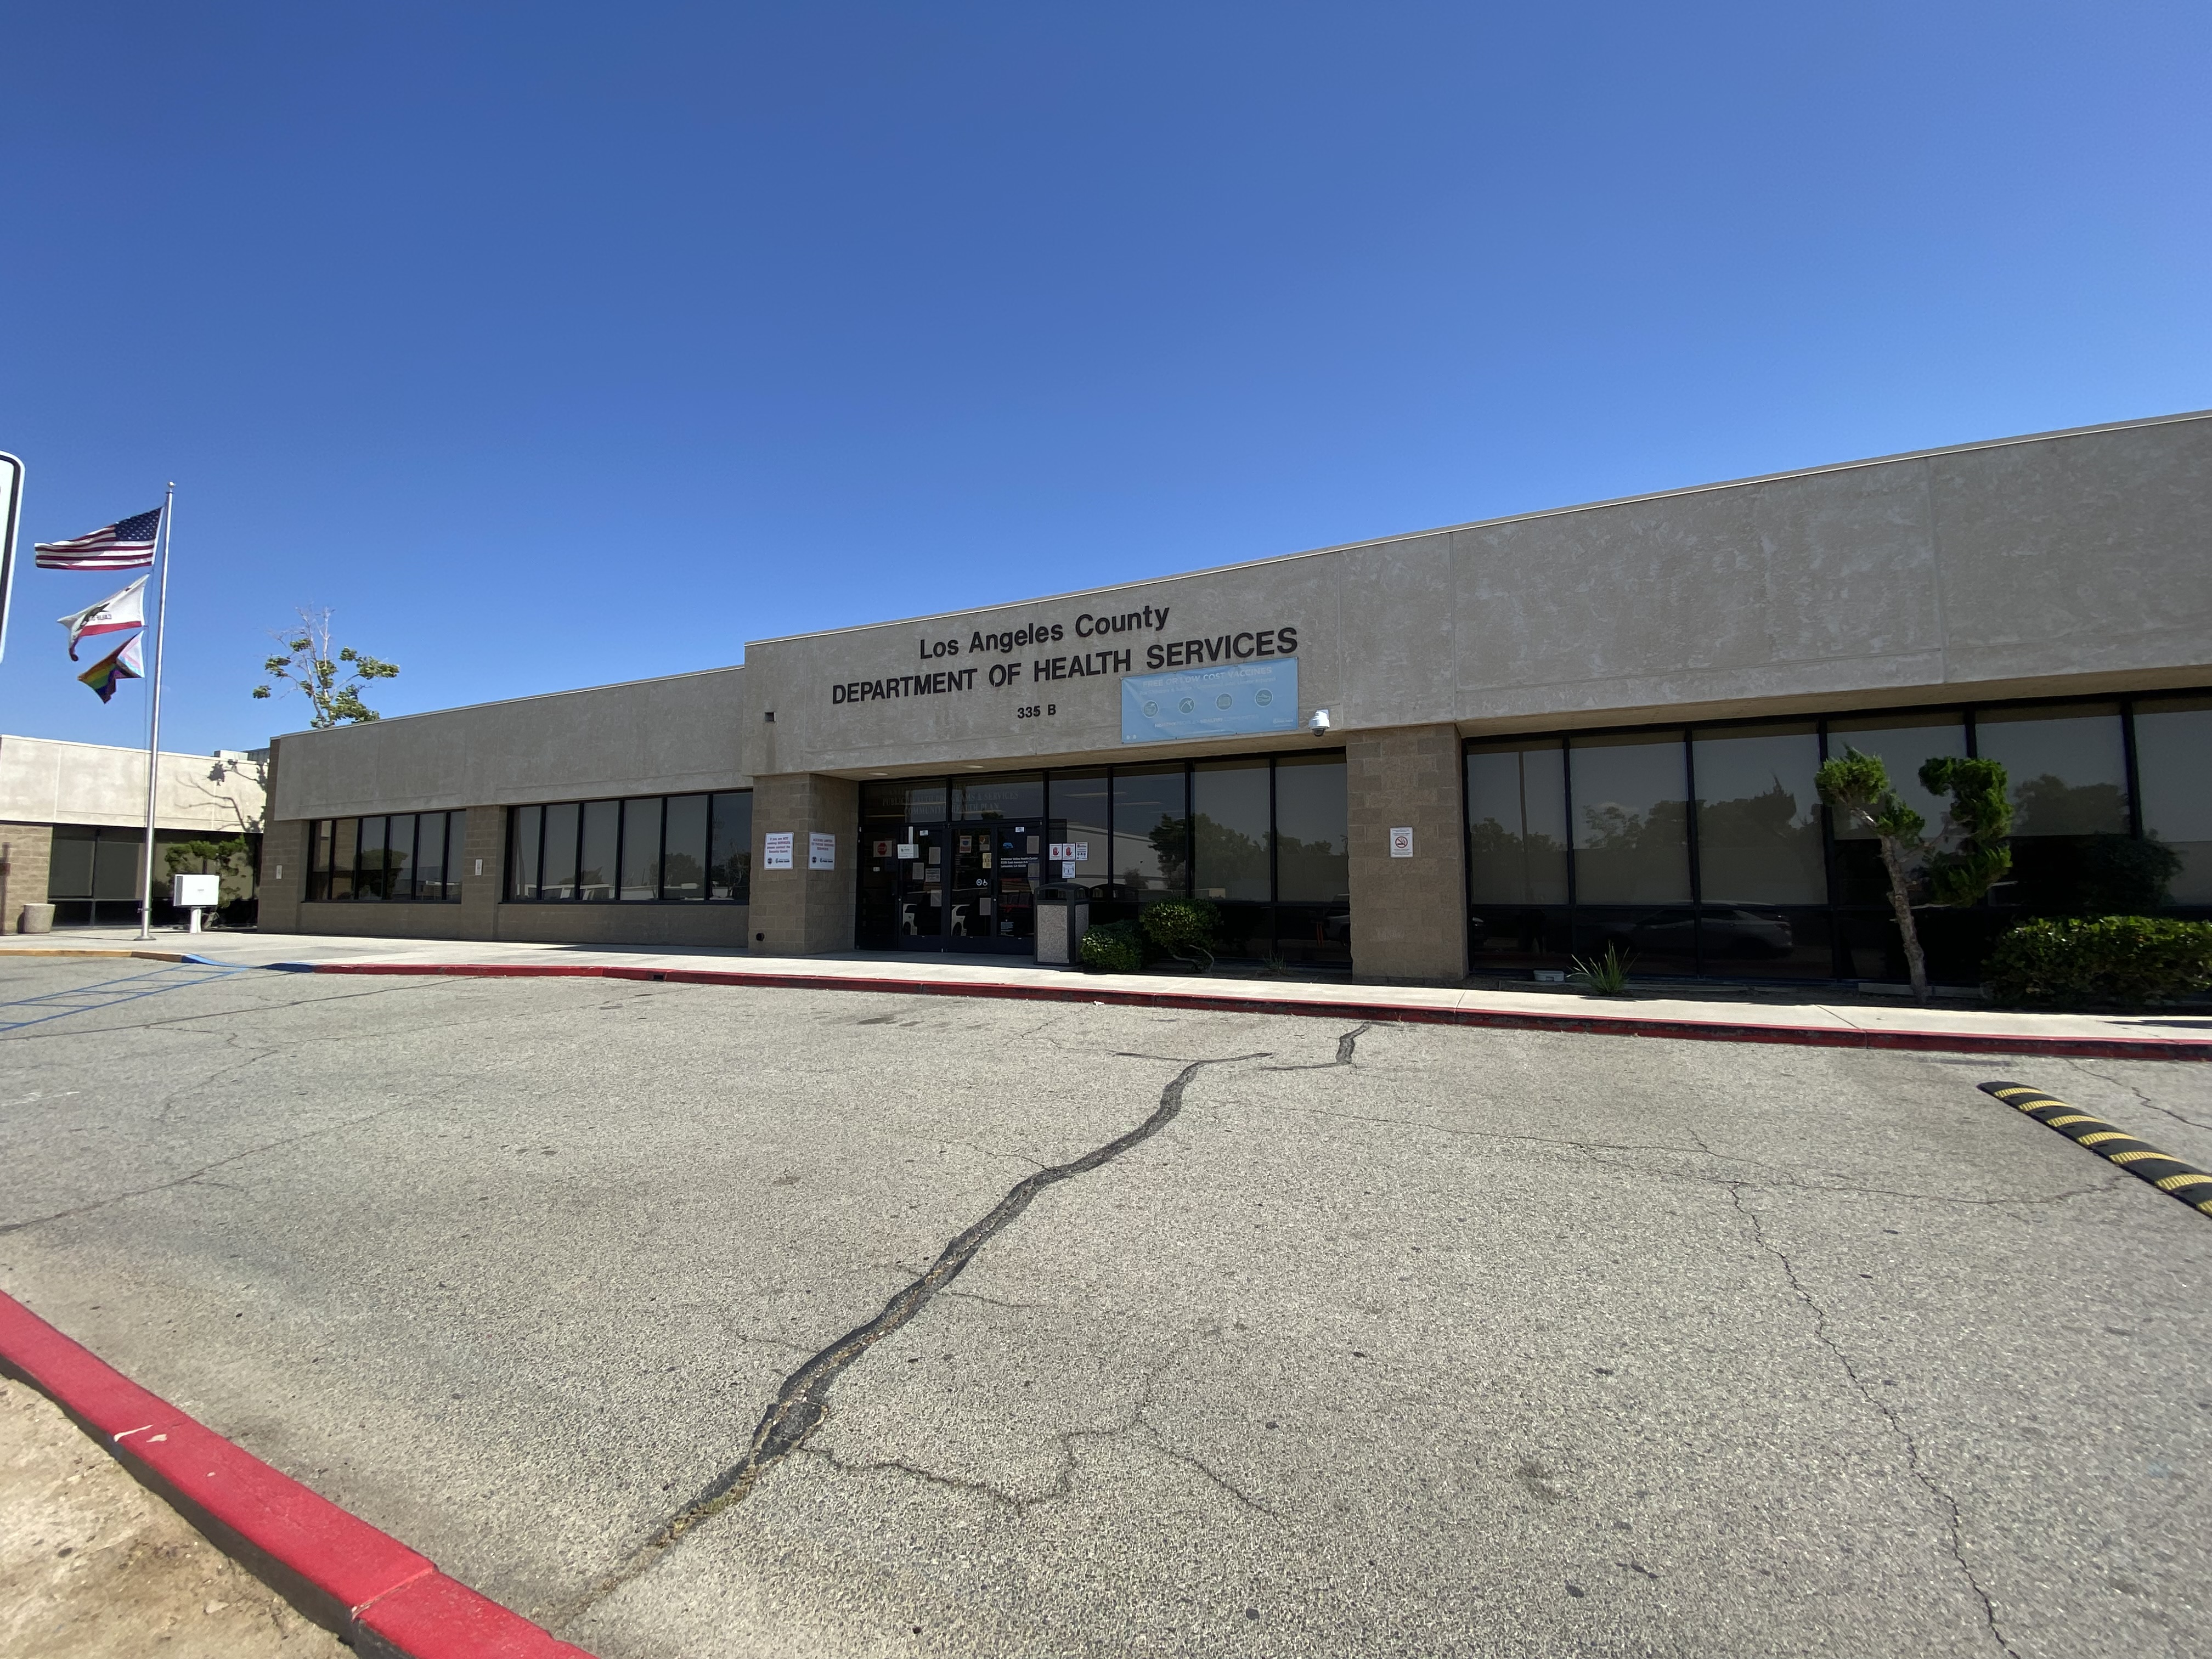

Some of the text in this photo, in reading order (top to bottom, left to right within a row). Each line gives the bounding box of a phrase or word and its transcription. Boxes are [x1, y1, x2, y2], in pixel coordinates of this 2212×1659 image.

[921, 605, 1170, 660] Los Angeles County
[832, 627, 1298, 705] DEPARTMENT OF HEALTH SERVICES
[1143, 679, 1164, 687] FREE
[1180, 675, 1200, 684] LOW
[1203, 672, 1225, 681] COST
[1228, 667, 1272, 678] VACCINES
[1017, 704, 1057, 719] 335 B
[883, 797, 905, 806] PUBLIC
[936, 792, 975, 802] PRGRAMS
[984, 791, 1019, 800] SERVICES
[905, 805, 946, 815] COMMUNITY
[980, 802, 999, 811] PLAN
